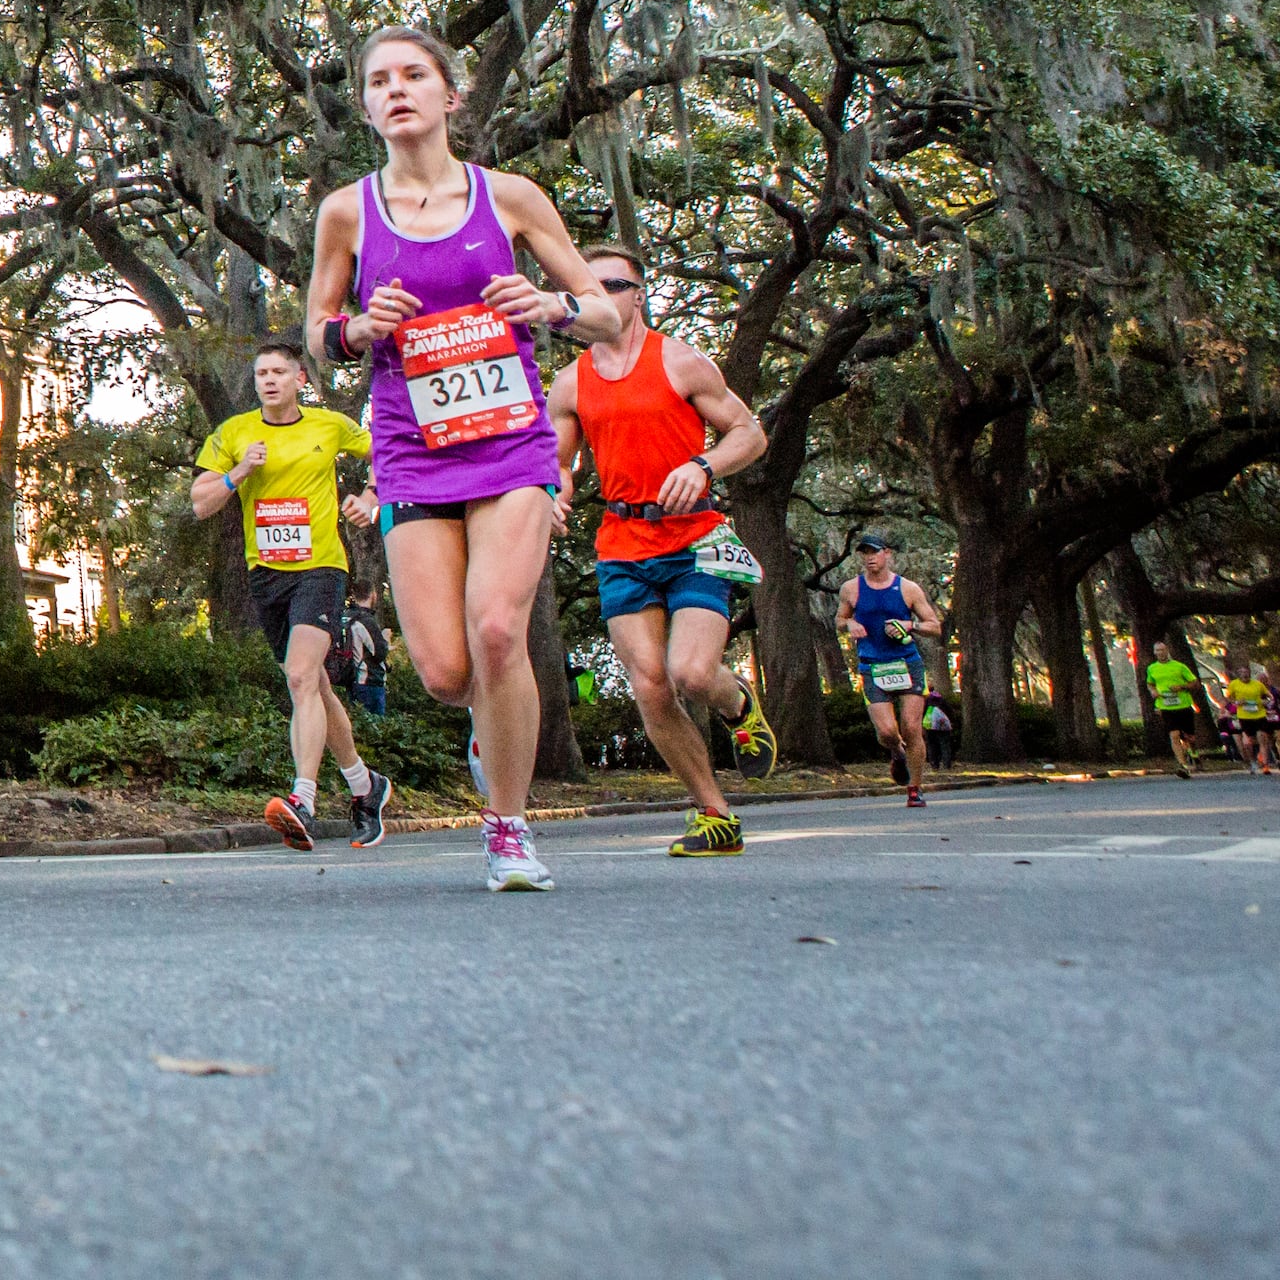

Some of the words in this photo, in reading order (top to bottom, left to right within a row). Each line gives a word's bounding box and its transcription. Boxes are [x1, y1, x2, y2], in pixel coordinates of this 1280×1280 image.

[402, 321, 506, 359] SAVANNAH
[427, 342, 488, 362] MARATHON
[429, 364, 509, 407] 3212
[265, 527, 301, 543] 1034
[880, 675, 905, 685] 1303
